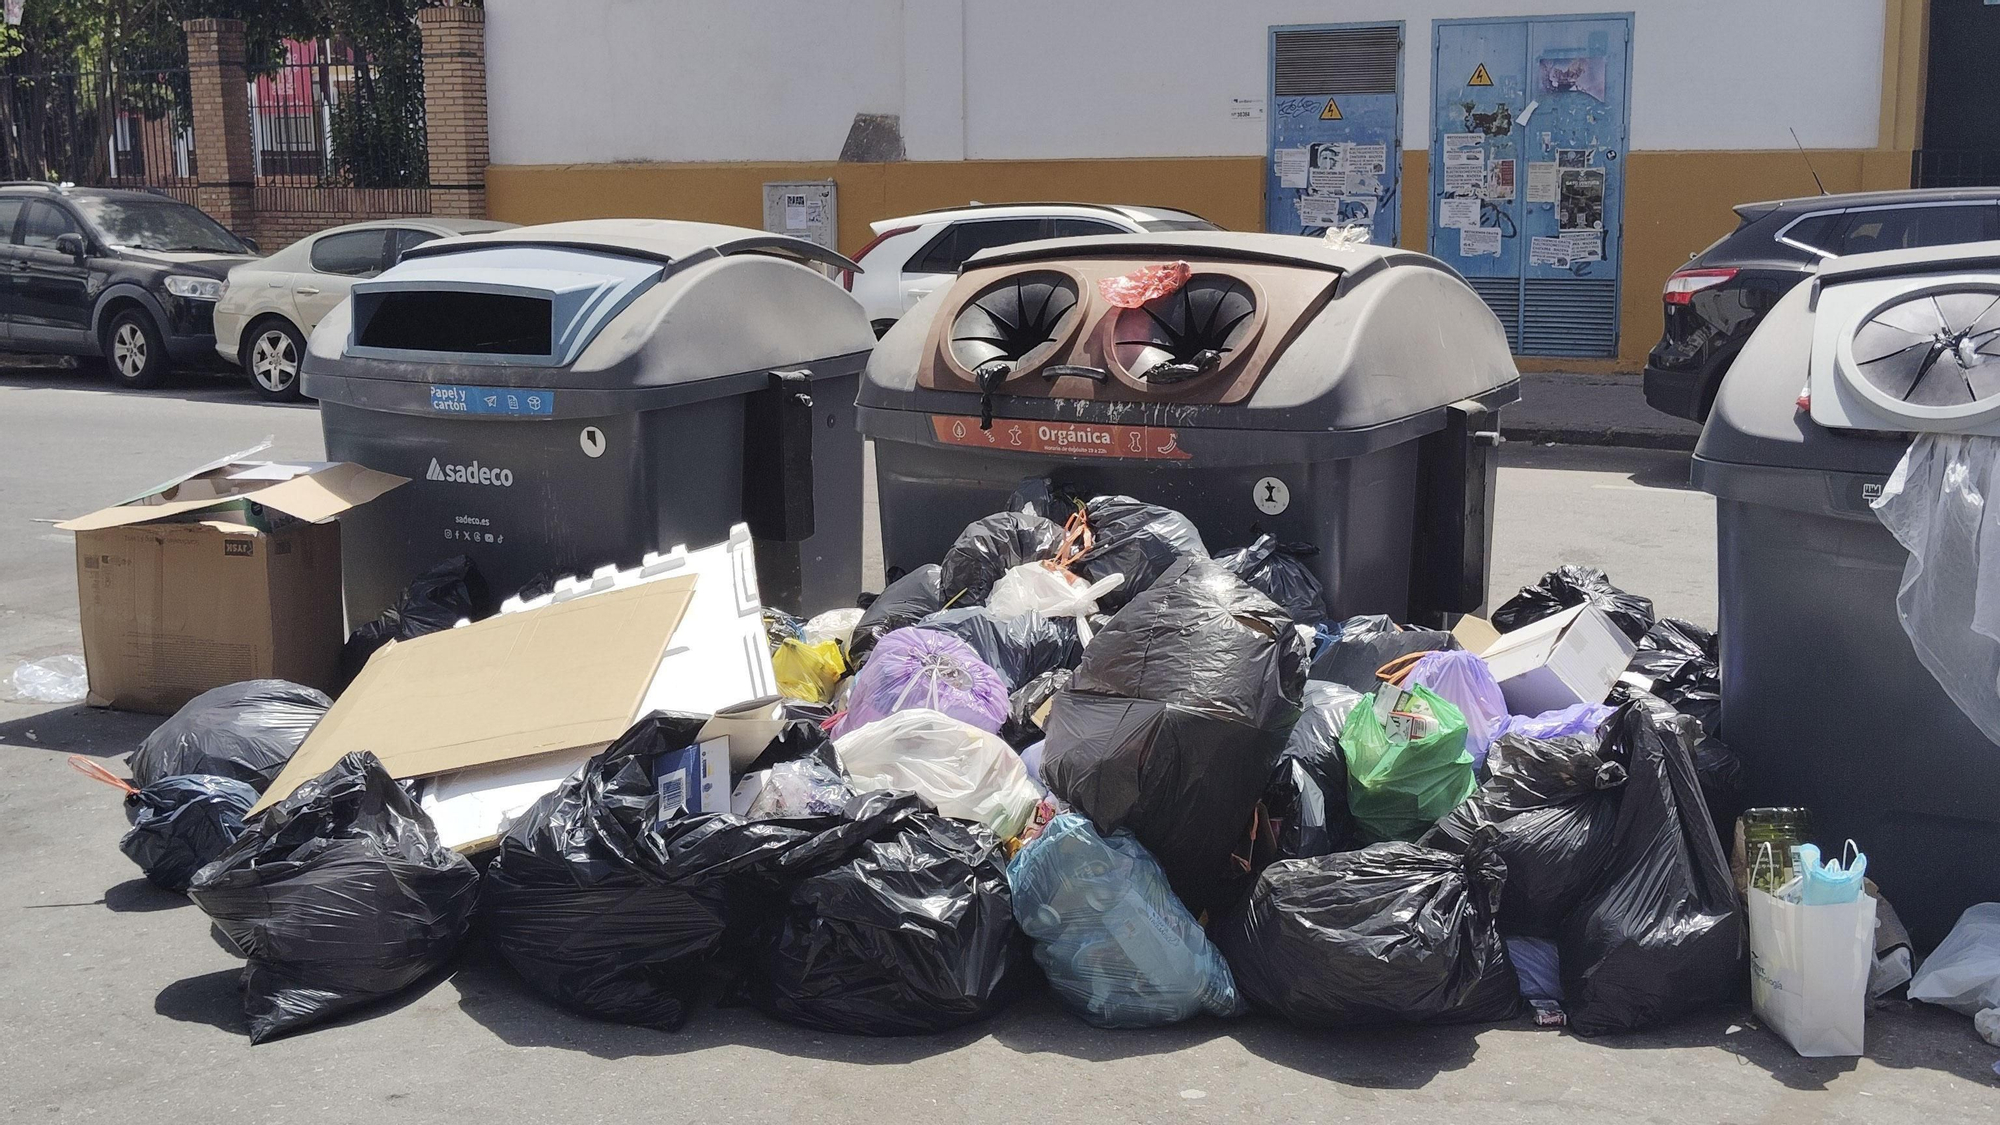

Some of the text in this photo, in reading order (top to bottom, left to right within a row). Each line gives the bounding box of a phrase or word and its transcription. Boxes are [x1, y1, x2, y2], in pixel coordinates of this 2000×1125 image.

[430, 386, 466, 401] Papel y
[433, 399, 467, 411] cartón
[1038, 424, 1111, 445] Orgánica
[445, 460, 514, 487] sadeco
[455, 514, 490, 526] sadeco.es
[226, 543, 248, 552] JYSK
